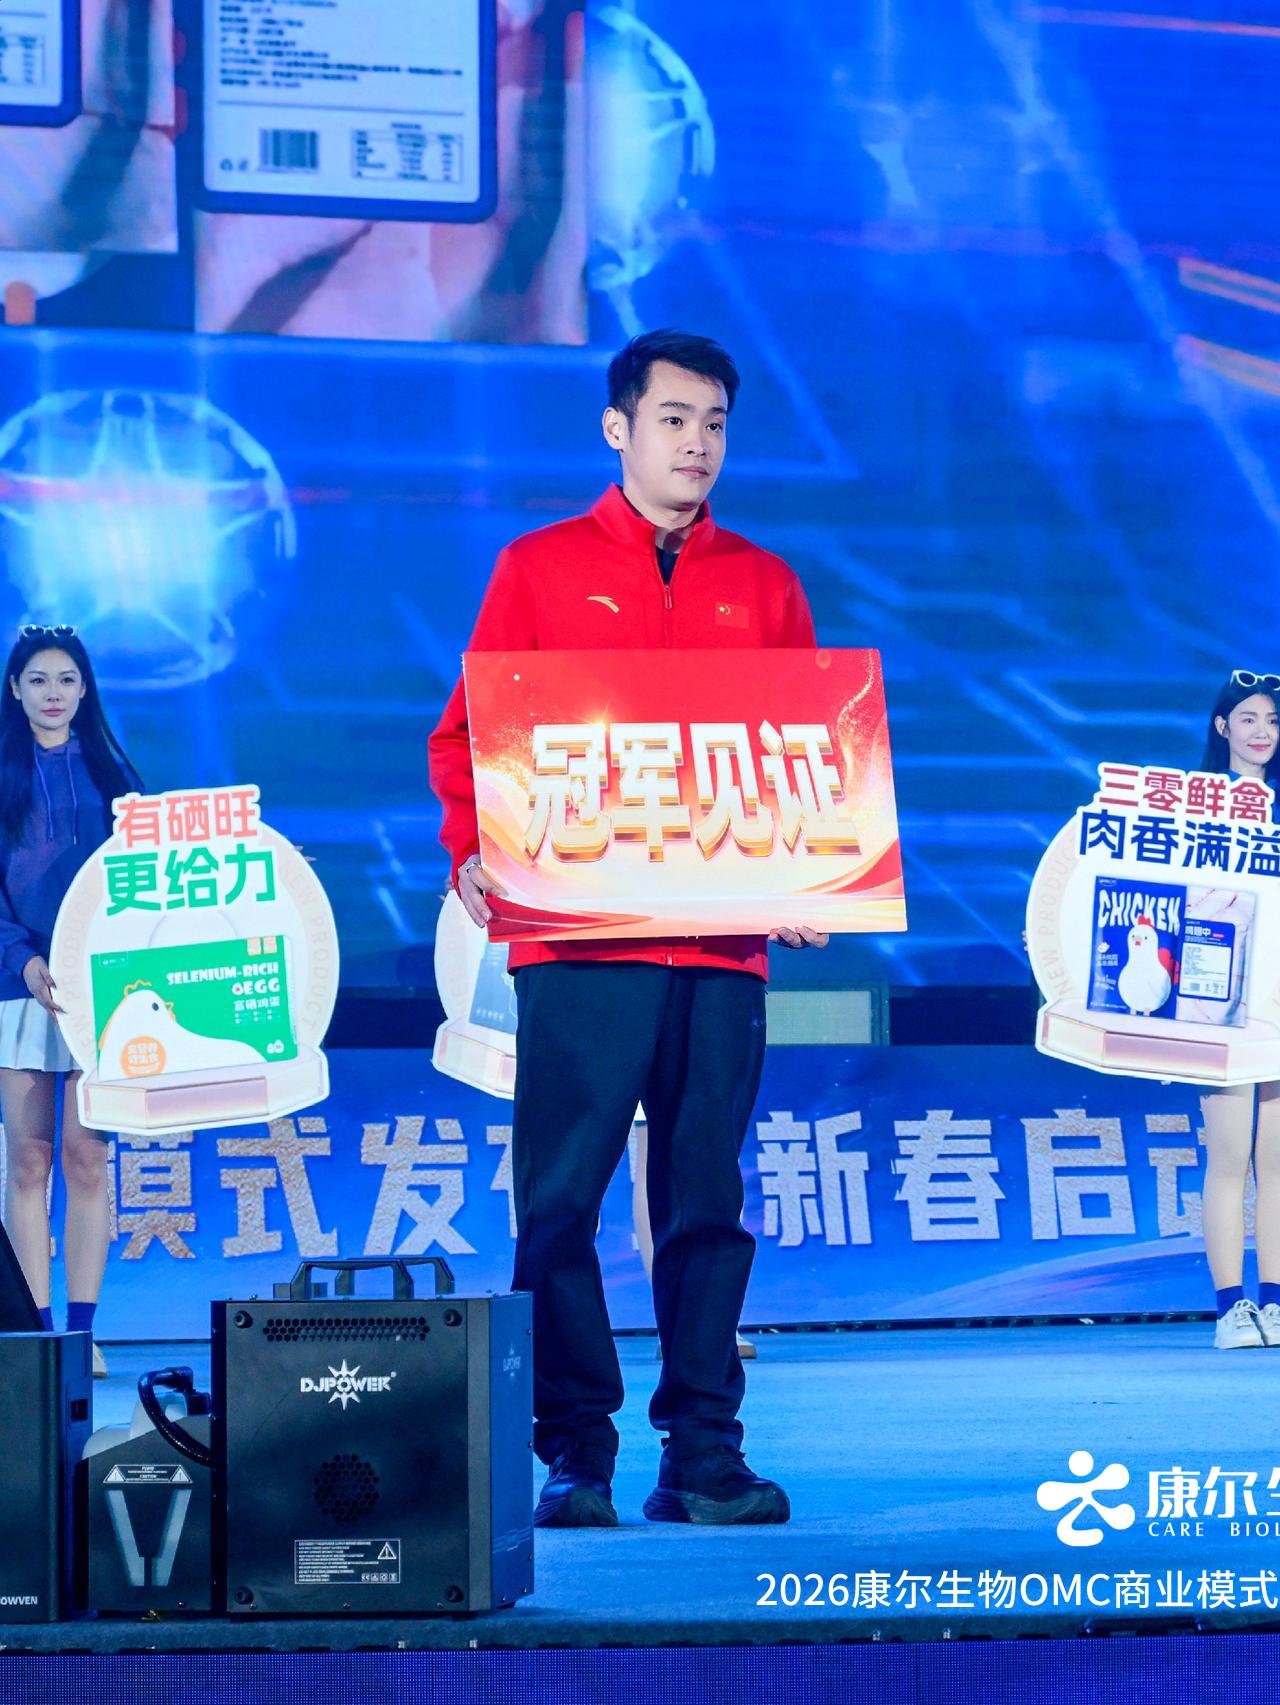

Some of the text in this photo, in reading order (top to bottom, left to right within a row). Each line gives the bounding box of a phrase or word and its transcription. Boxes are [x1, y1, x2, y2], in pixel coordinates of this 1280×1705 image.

[524, 719, 862, 863] 冠军见证
[1099, 766, 1270, 824] 三零鲜禽
[117, 789, 258, 848] 有硒旺
[103, 843, 277, 916] 更给力
[1037, 843, 1076, 936] PRODUC
[1097, 888, 1181, 937] CHICKEN
[166, 961, 280, 986] SELENIUM-RICH
[242, 977, 281, 996] EGG
[299, 1375, 393, 1393] DJPOWER
[0, 1596, 38, 1605] OWVEN
